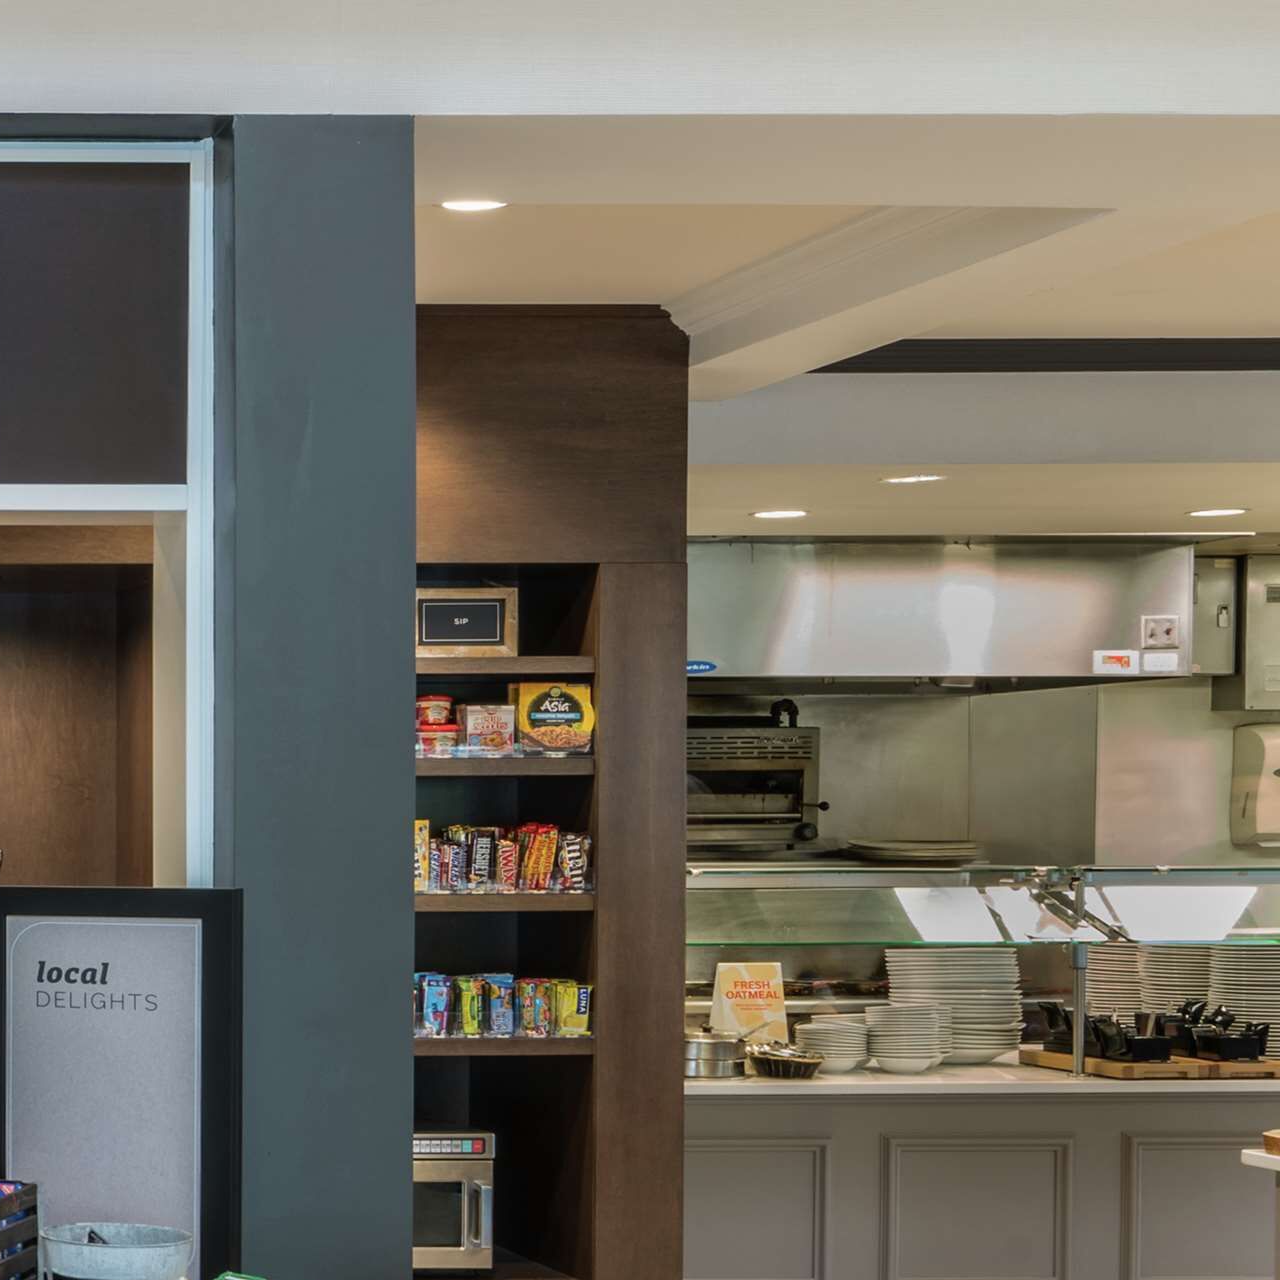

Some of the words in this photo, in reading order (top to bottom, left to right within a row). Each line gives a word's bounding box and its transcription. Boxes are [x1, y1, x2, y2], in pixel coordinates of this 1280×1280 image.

[540, 700, 571, 712] Asia
[501, 844, 515, 886] TWIX
[36, 961, 109, 985] local
[725, 991, 781, 1000] OATMEAL
[733, 980, 771, 989] FRESH
[35, 990, 159, 1012] DELIGHTS
[579, 988, 588, 1013] LUNA
